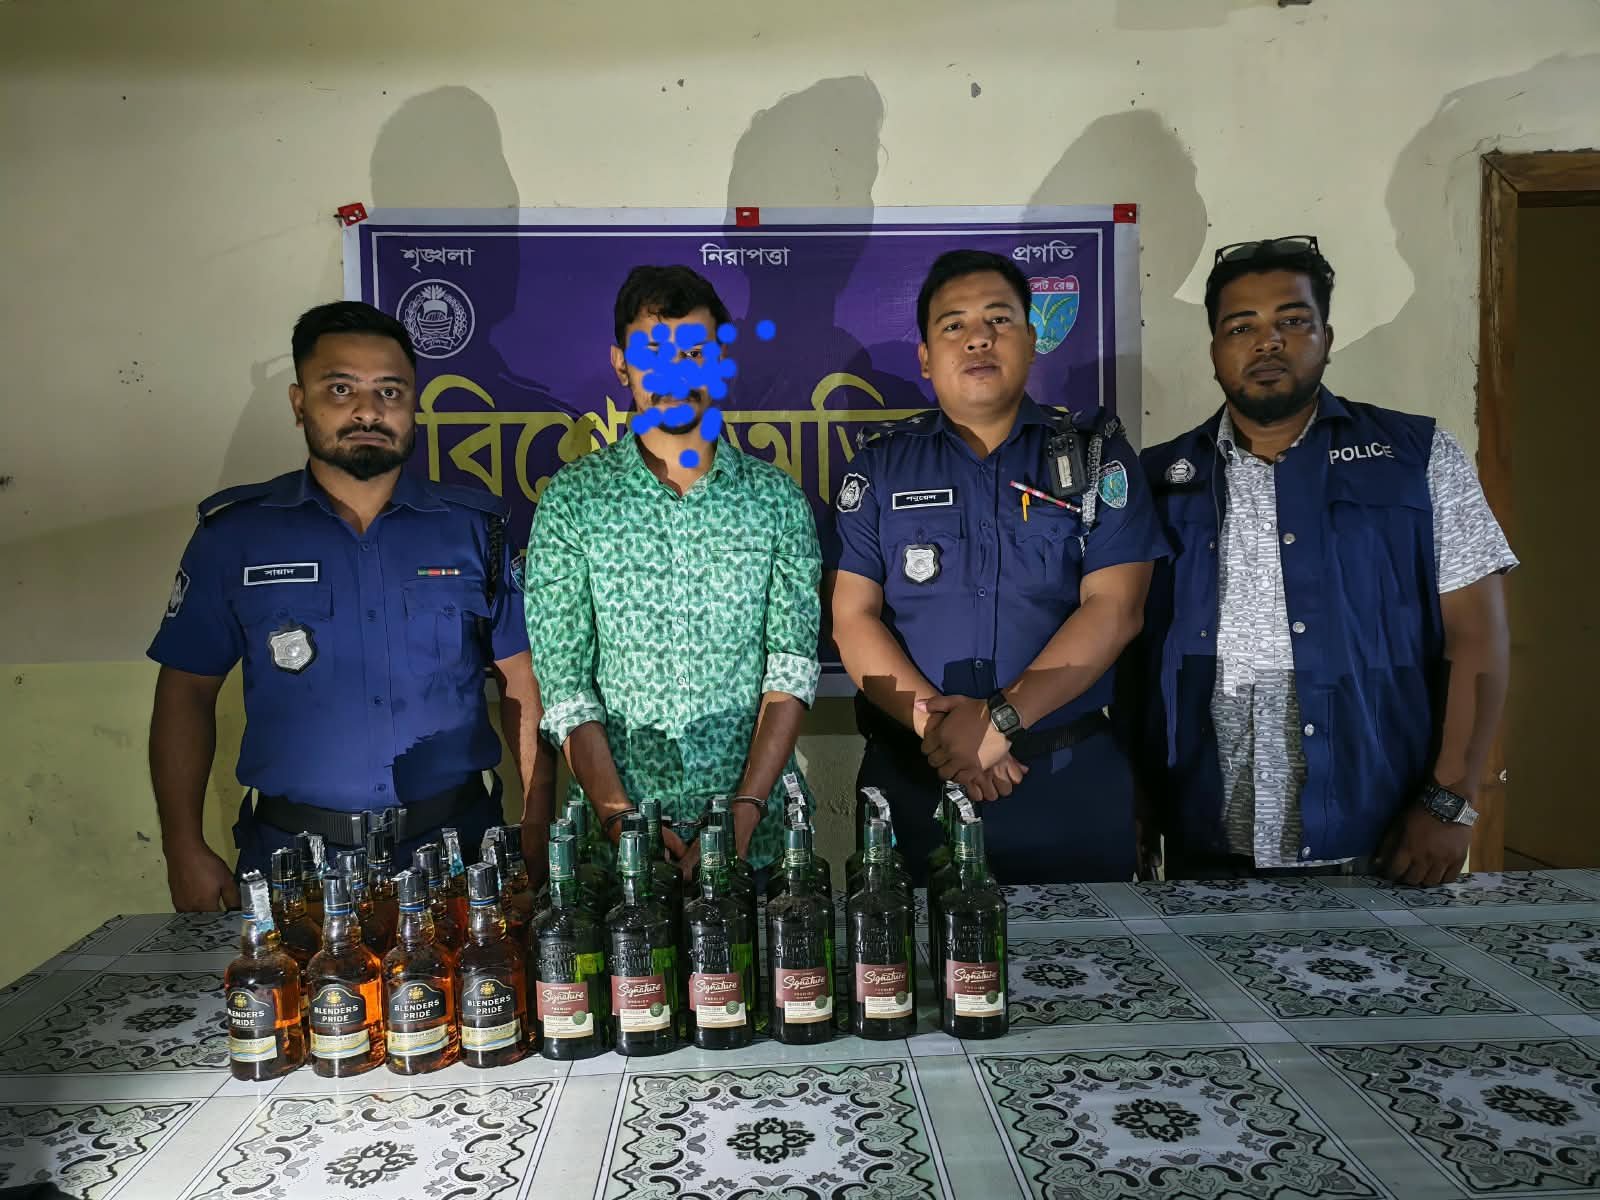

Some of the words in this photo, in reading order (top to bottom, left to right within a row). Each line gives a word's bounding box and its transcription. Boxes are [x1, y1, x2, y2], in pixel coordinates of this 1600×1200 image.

[699, 242, 791, 266] নিরাপত্তা
[1012, 240, 1078, 264] প্রগতি
[399, 247, 476, 273] শৃঙ্খলা
[415, 374, 641, 504] বিশে
[1328, 442, 1395, 465] POLICE
[783, 975, 826, 990] Signature
[863, 970, 906, 985] Signature
[617, 982, 661, 998] Signature
[695, 979, 737, 994] Signature
[467, 994, 511, 1008] BLENDERS
[541, 989, 584, 1004] Signature
[314, 1004, 359, 1016] BLENDERS
[394, 999, 440, 1012] BLENDERS
[476, 1005, 503, 1015] PRIDE
[321, 1014, 349, 1023] PRIDE
[403, 1010, 431, 1020] PRIDE
